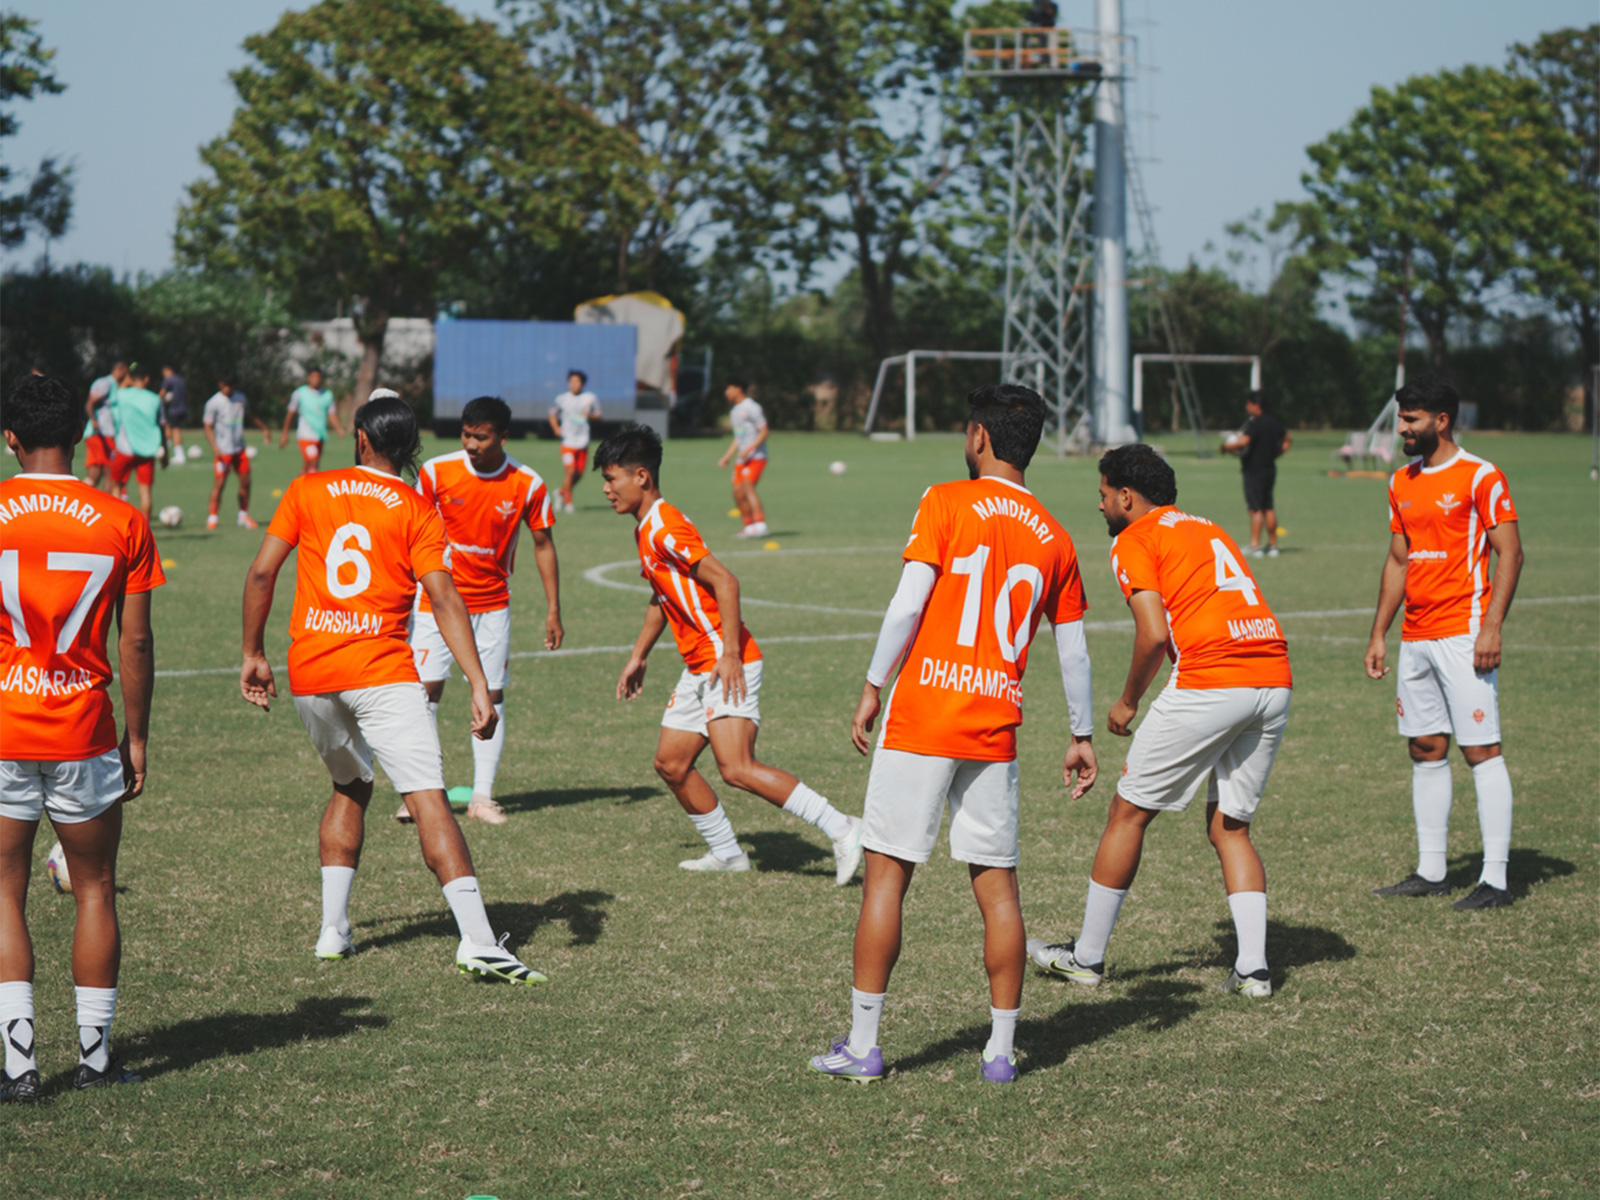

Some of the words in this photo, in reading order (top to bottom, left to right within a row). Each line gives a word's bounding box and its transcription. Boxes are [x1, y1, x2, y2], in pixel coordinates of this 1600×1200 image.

[0, 493, 102, 527] NAMDHARI
[326, 480, 403, 509] NAMDHARI
[972, 496, 1054, 545] NAMDHARI
[325, 521, 372, 599] 6
[1210, 537, 1257, 606] 4
[0, 549, 115, 654] 17
[305, 606, 382, 635] GURSHAAN
[951, 544, 1044, 663] 10
[1227, 617, 1279, 641] MANBIR
[417, 649, 429, 666] 7
